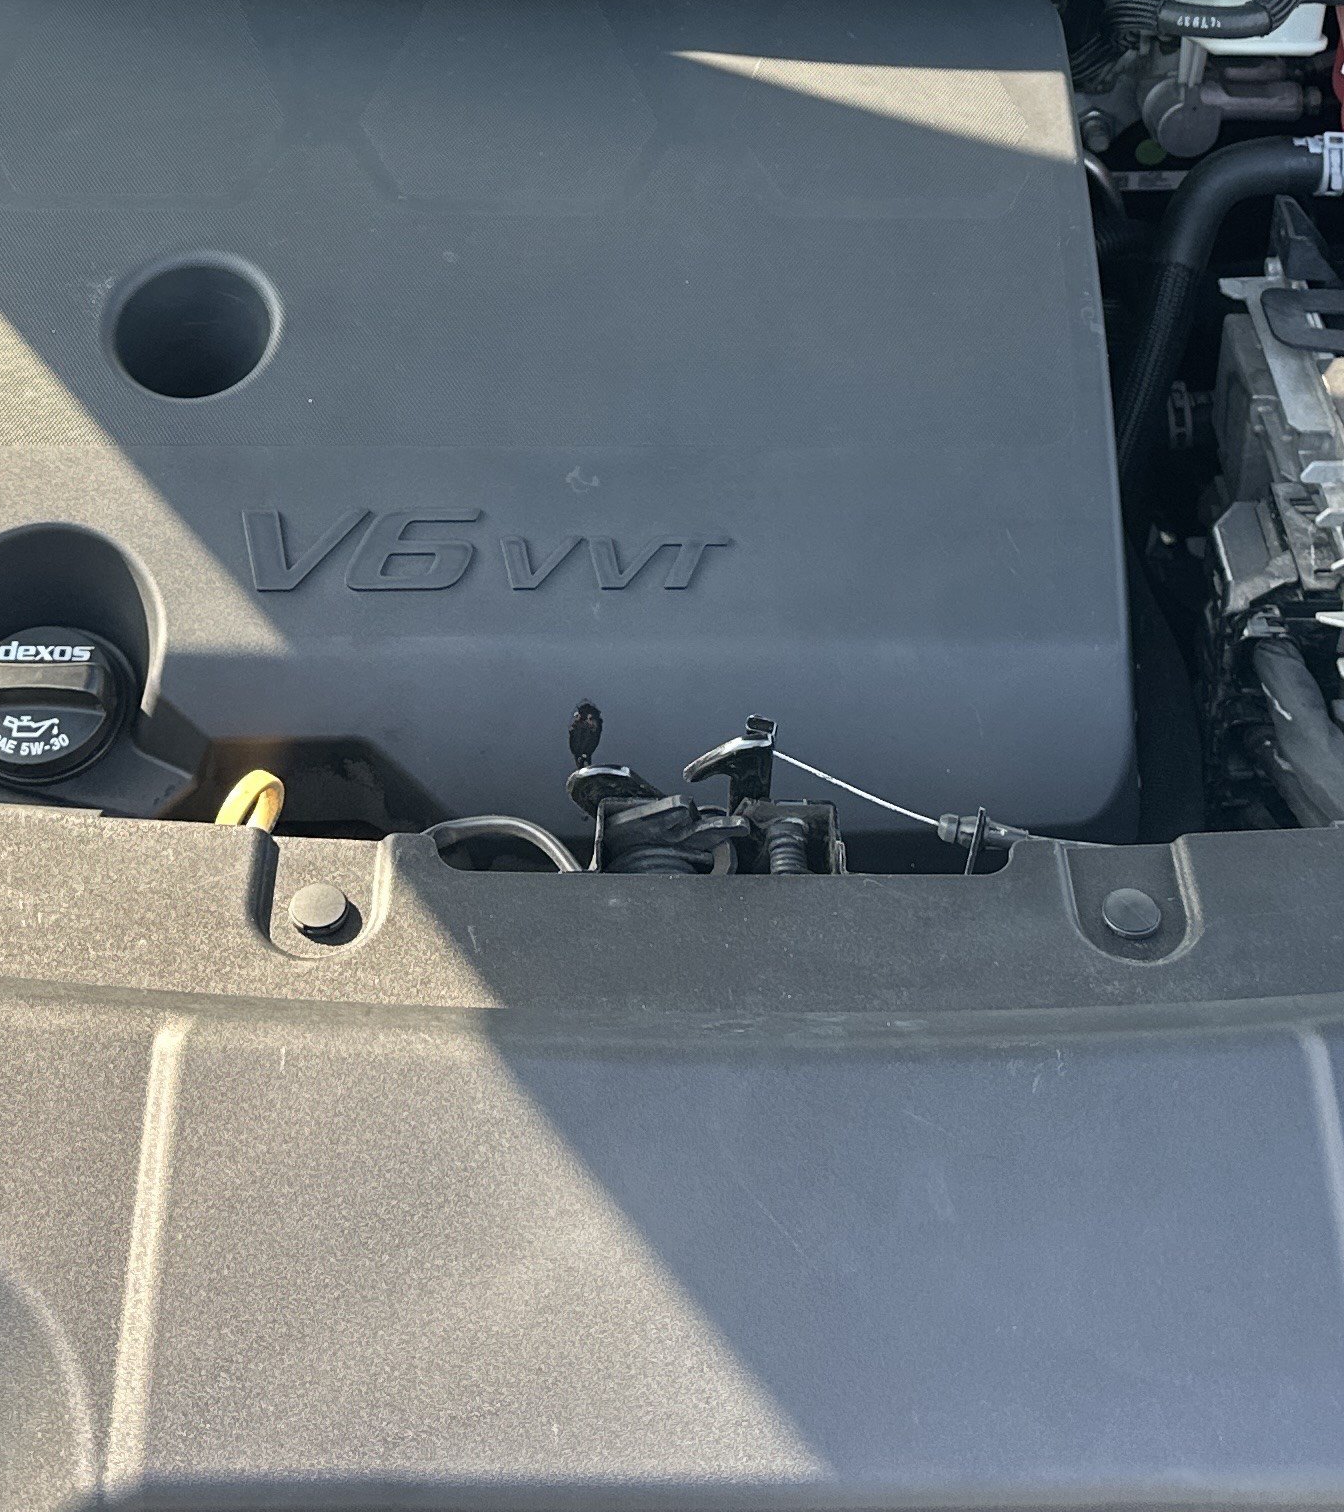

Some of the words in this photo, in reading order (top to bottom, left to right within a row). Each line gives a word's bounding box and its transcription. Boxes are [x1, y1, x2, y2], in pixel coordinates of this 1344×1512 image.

[240, 506, 484, 594] V6
[501, 534, 734, 592] VVT
[19, 733, 71, 756] 5W-30
